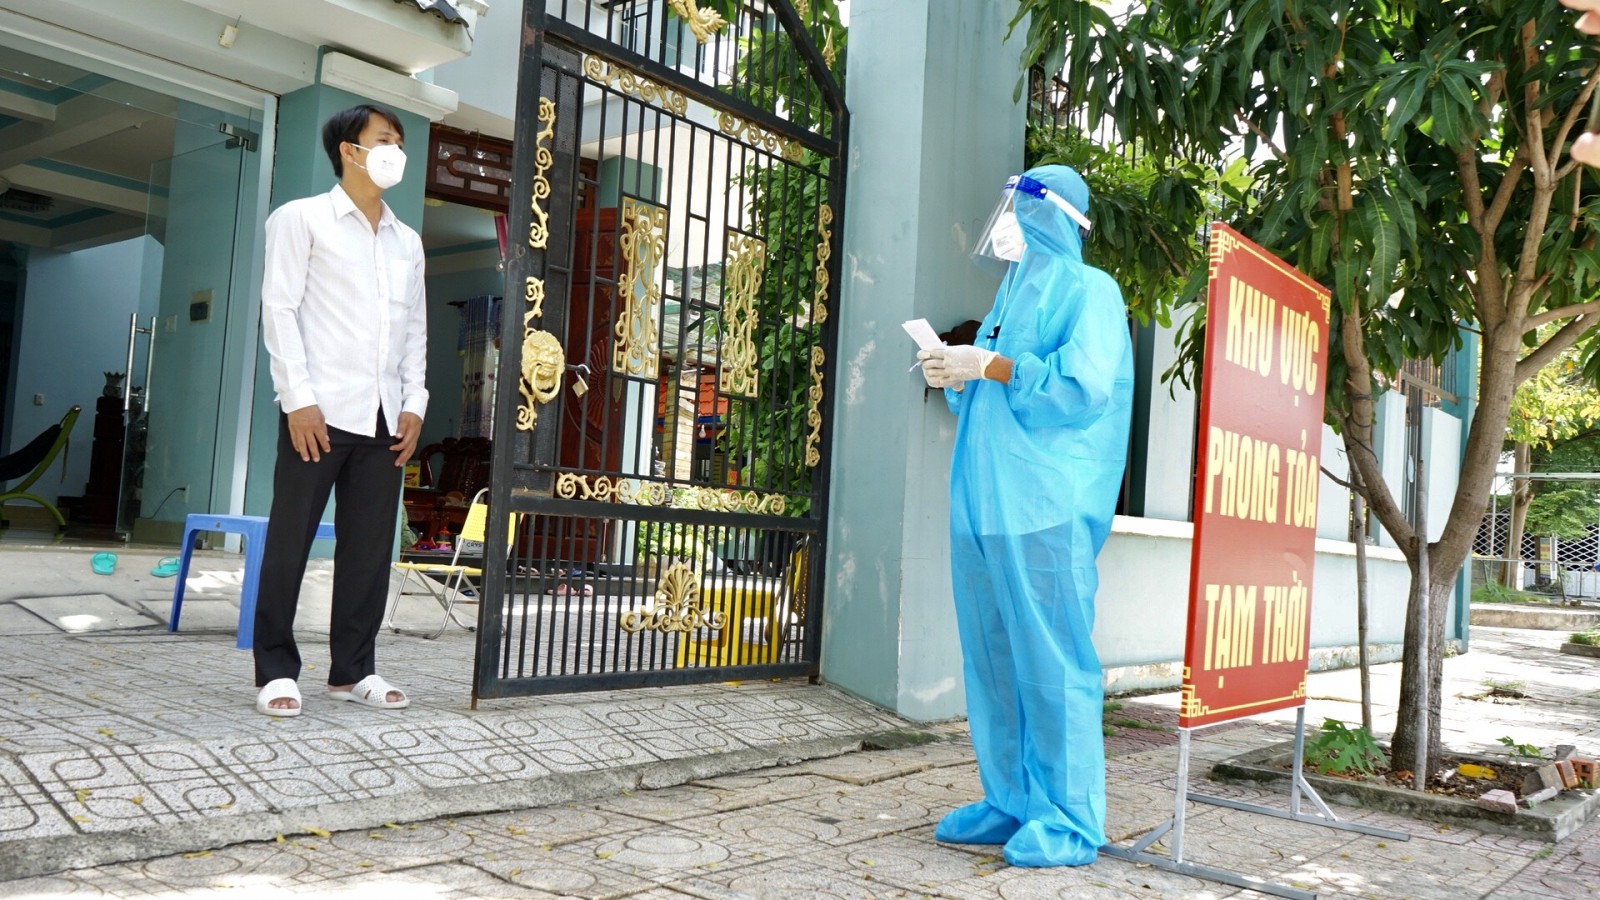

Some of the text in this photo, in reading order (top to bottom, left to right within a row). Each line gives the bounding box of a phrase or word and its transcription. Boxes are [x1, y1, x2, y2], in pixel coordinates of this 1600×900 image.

[1225, 276, 1319, 406] KHU VỰC
[1205, 427, 1317, 529] PHONG TỎA
[1204, 571, 1307, 689] TẠM THỜI
